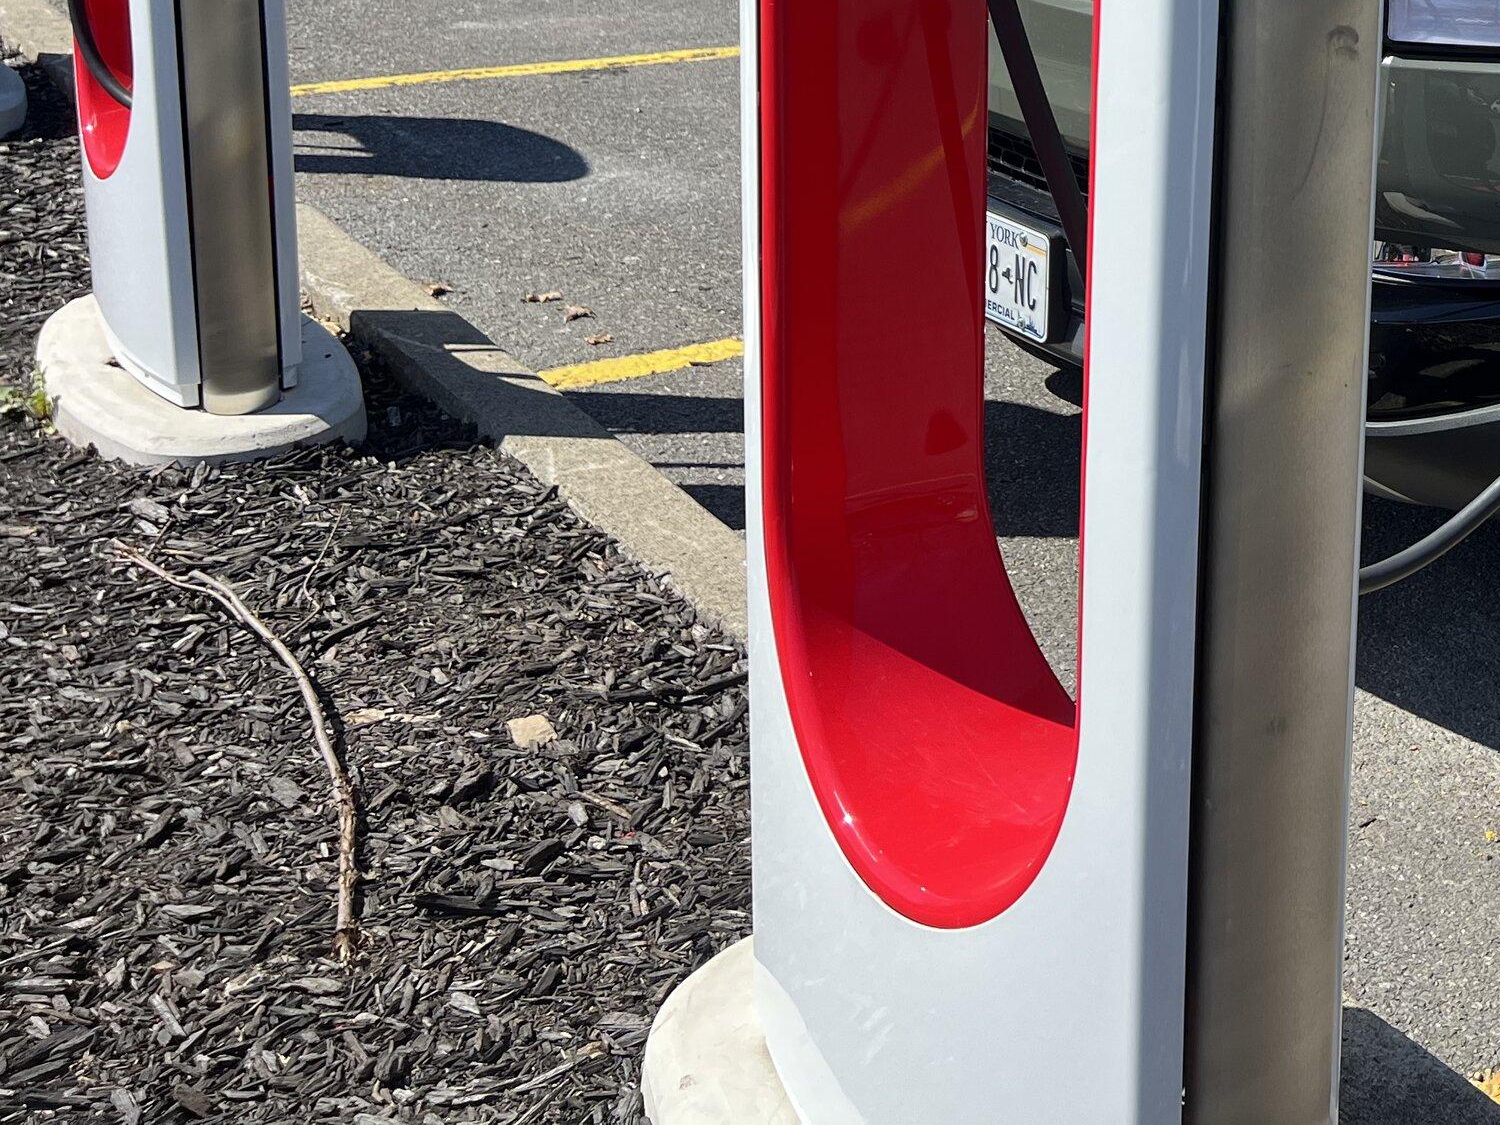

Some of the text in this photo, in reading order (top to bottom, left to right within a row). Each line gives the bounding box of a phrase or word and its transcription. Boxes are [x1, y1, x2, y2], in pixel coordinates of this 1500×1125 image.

[989, 222, 1019, 250] YORK
[989, 244, 999, 294] 8
[987, 302, 1016, 321] ERCIAL
